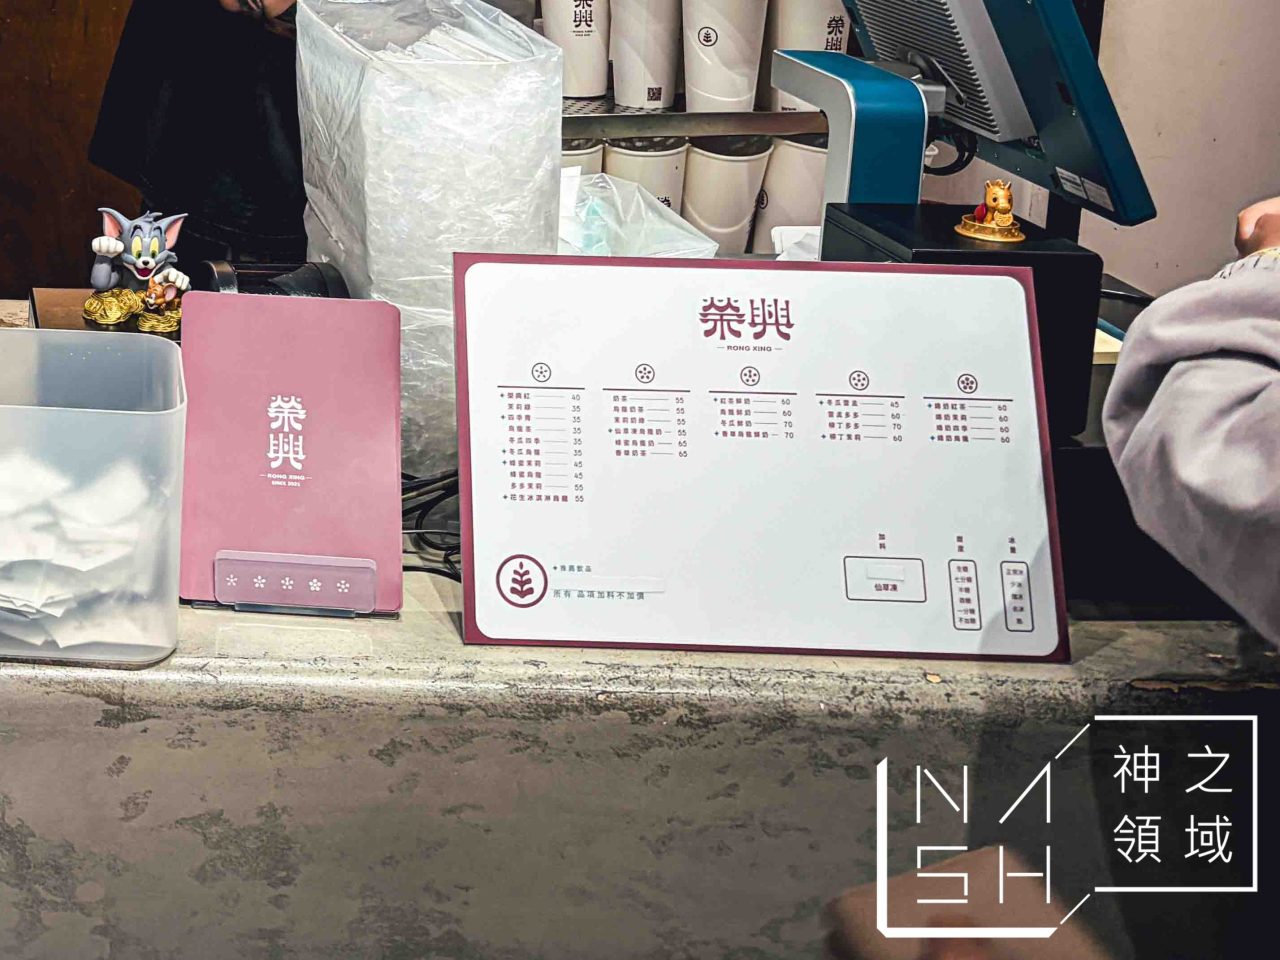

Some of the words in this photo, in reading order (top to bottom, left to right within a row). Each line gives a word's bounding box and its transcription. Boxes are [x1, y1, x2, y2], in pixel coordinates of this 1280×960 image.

[699, 297, 795, 341] 榮興
[267, 395, 307, 470] 榮興
[874, 583, 898, 592] 仙草凍
